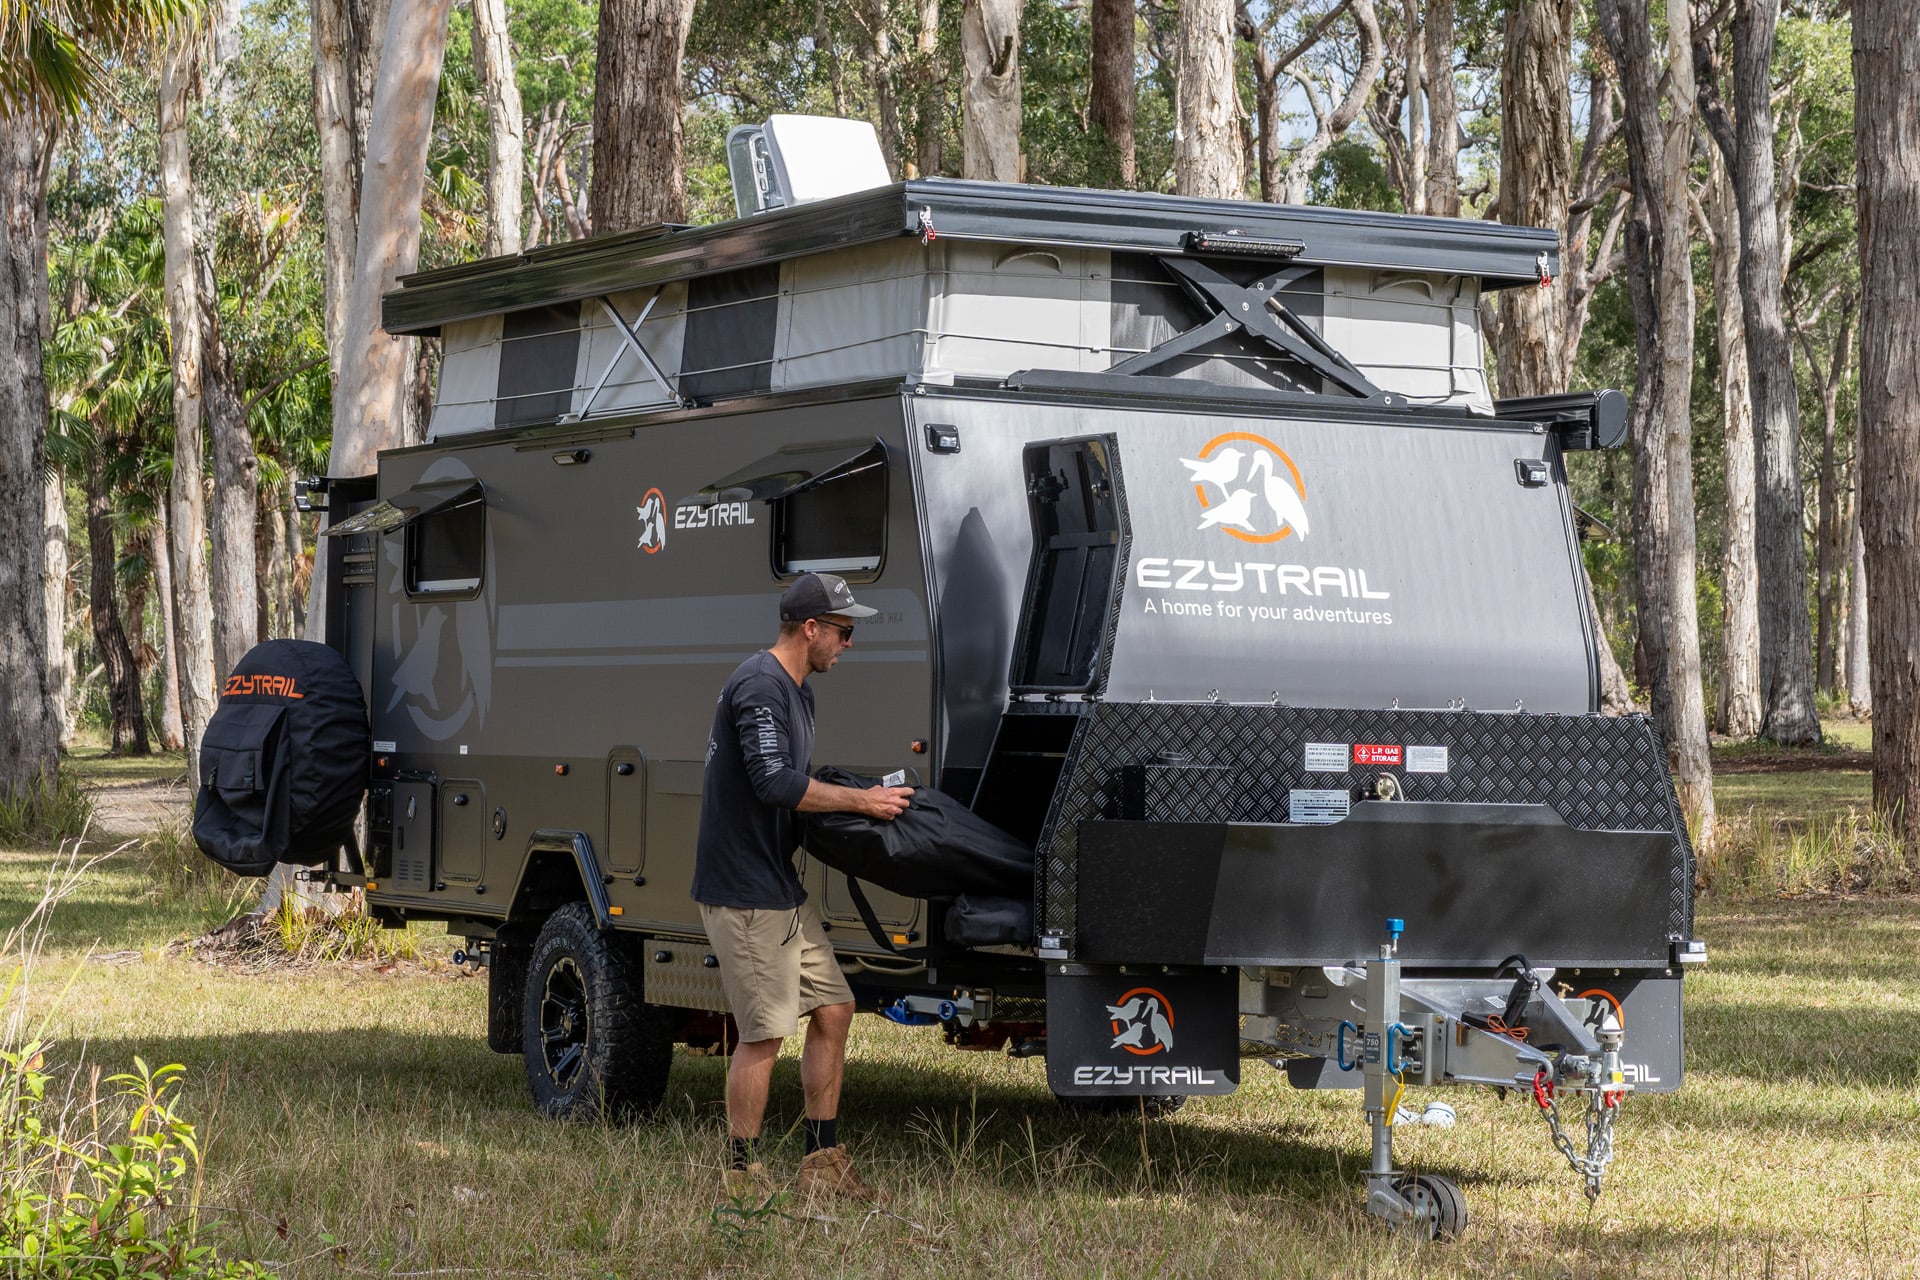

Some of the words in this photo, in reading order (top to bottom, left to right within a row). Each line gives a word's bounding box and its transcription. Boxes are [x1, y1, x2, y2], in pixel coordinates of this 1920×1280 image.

[675, 502, 755, 529] EZYTRAIL
[1136, 557, 1391, 600] EZYTRAIL
[1144, 598, 1157, 614] A
[1162, 598, 1213, 617] home
[1217, 600, 1243, 618] for
[1248, 606, 1288, 622] your
[1292, 605, 1392, 625] adventures
[222, 674, 305, 699] EZYTRAIL
[1384, 747, 1399, 755] GAS
[1366, 1038, 1379, 1046] 750
[1074, 1066, 1215, 1085] EZYTRAIL
